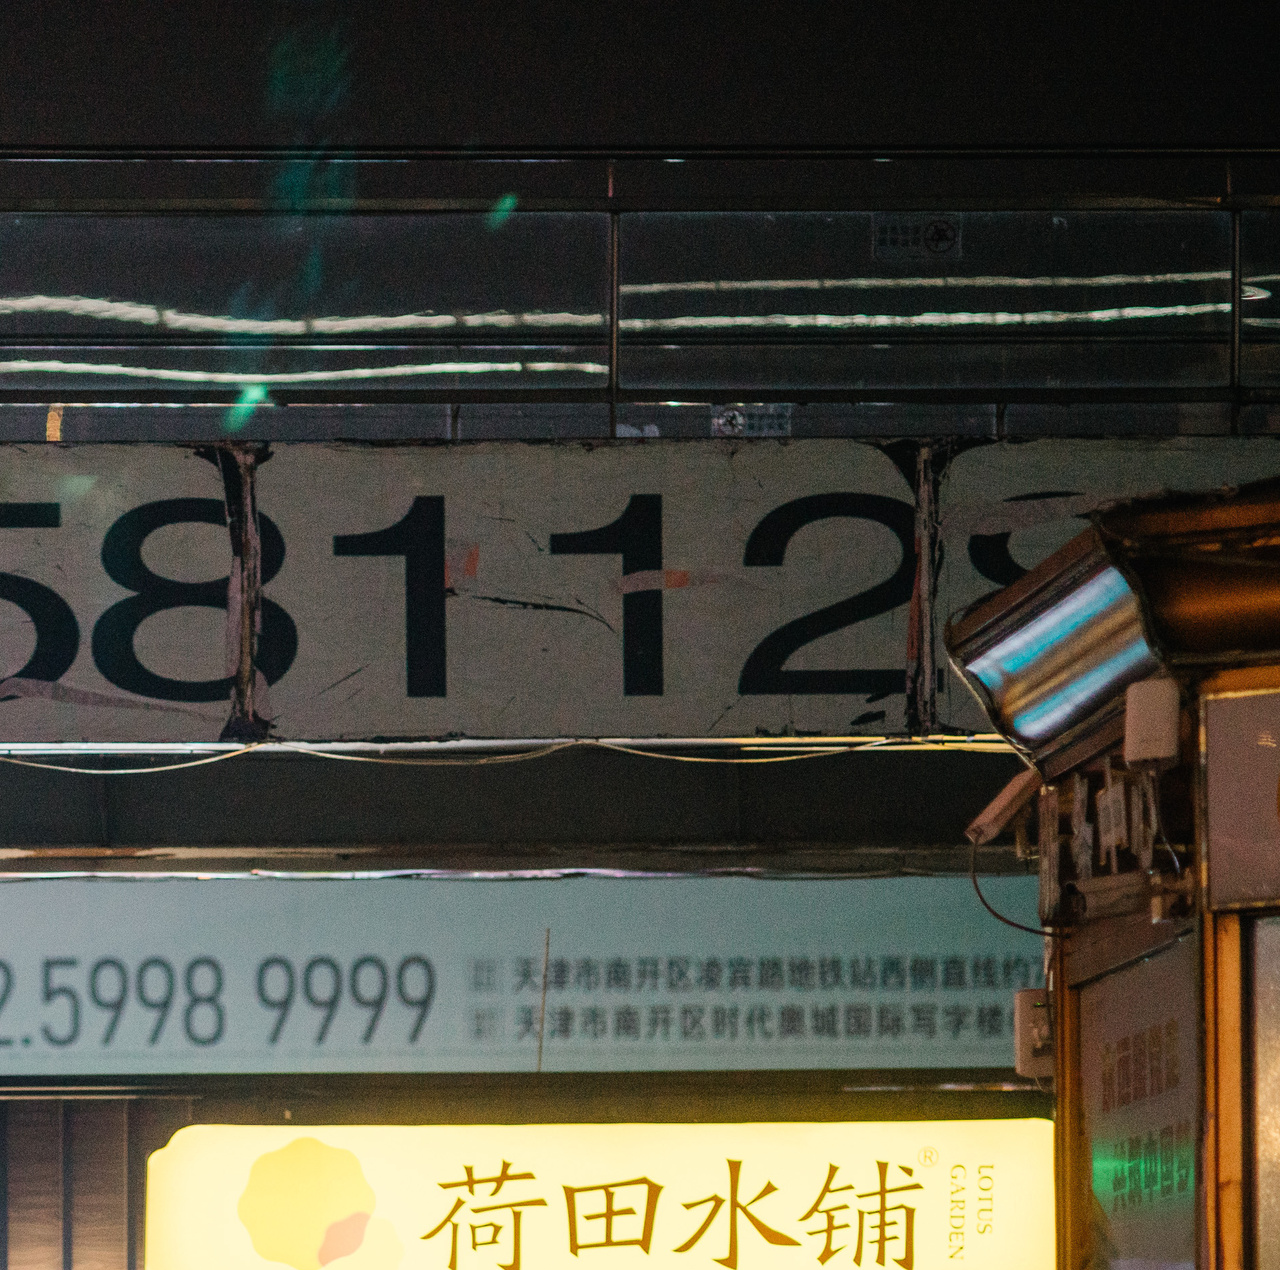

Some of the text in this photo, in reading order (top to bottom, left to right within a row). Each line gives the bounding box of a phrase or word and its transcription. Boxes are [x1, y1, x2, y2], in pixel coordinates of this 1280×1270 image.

[256, 955, 437, 1048] 9999
[948, 1163, 968, 1260] GARDEN
[976, 1163, 995, 1235] LOTUS
